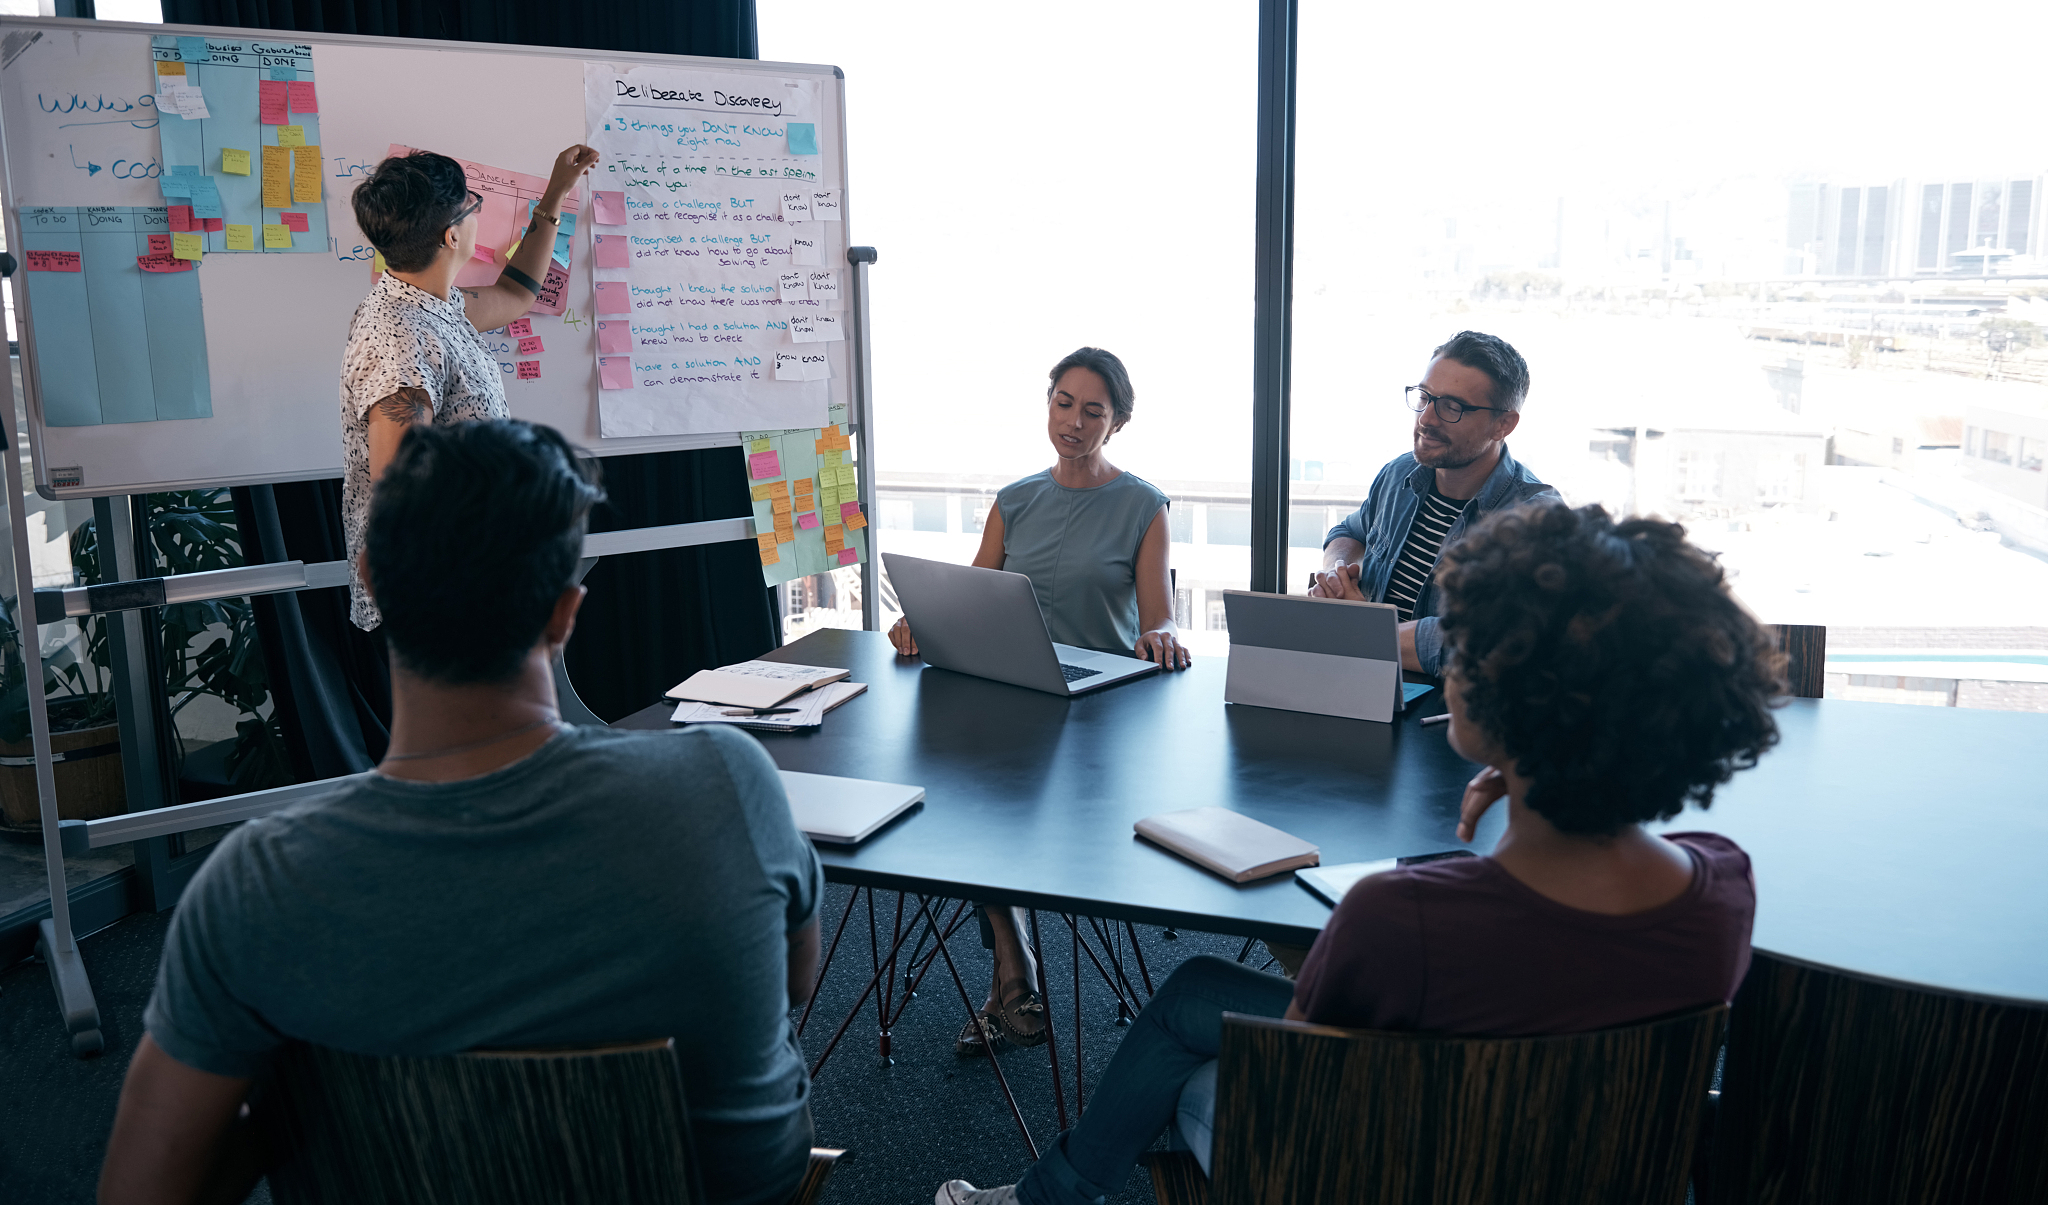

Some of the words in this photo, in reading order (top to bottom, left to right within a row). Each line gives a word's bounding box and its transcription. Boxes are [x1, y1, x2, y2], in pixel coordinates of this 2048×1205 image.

[174, 51, 182, 61] D
[203, 54, 240, 64] OING
[262, 56, 296, 67] DONE
[615, 118, 628, 131] 3
[631, 119, 674, 137] things
[677, 125, 696, 139] you
[743, 124, 784, 137] KNOW
[715, 137, 741, 148] now
[617, 160, 649, 174] Think
[656, 160, 667, 175] of
[673, 166, 681, 174] a
[684, 164, 707, 174] time
[715, 164, 727, 174] in
[731, 164, 752, 176] the
[758, 164, 778, 177] last
[465, 164, 516, 186] SANELE
[624, 178, 660, 188] when
[665, 180, 692, 192] you:
[594, 192, 603, 201] A
[662, 200, 669, 208] a
[673, 198, 722, 213] challenge
[729, 197, 755, 208] BUT
[787, 203, 808, 212] know
[816, 200, 838, 208] know
[52, 215, 67, 224] DO
[88, 213, 123, 226] DOING
[632, 211, 651, 221] did
[654, 211, 670, 221] not
[673, 211, 718, 224] recognise
[721, 211, 728, 220] it
[732, 213, 744, 222] as
[745, 213, 753, 221] a
[755, 210, 802, 227] challe
[595, 234, 603, 244] B
[630, 234, 684, 249] recognised
[700, 234, 743, 247] challenge
[750, 233, 771, 243] BUT
[794, 237, 813, 247] know
[636, 248, 652, 258] did
[654, 249, 669, 257] not
[673, 247, 700, 257] know
[706, 246, 729, 256] how
[732, 247, 742, 255] to
[745, 248, 759, 258] go
[764, 244, 793, 255] about
[718, 257, 756, 269] solving
[759, 257, 769, 266] it
[595, 282, 605, 291] C
[631, 284, 672, 299] thought
[680, 282, 684, 292] I
[688, 283, 716, 294] knew
[720, 283, 735, 294] the
[740, 282, 776, 294] solution
[782, 281, 805, 290] know
[812, 281, 836, 290] know
[636, 298, 654, 309] did
[656, 297, 673, 308] not
[679, 297, 706, 307] know
[710, 297, 735, 307] there
[740, 298, 759, 307] was
[598, 322, 607, 330] D
[631, 322, 675, 337] thought
[679, 322, 684, 331] I
[688, 322, 709, 331] had
[713, 324, 720, 332] a
[723, 321, 760, 332] solution
[765, 320, 788, 331] AND
[640, 334, 668, 346] knew
[672, 332, 694, 343] how
[699, 333, 709, 343] to
[713, 333, 743, 343] check
[599, 357, 608, 366] E
[634, 360, 663, 373] have
[671, 362, 680, 370] a
[685, 359, 727, 370] solution
[733, 356, 762, 367] AND
[801, 355, 825, 363] know
[643, 378, 664, 387] can
[669, 373, 742, 385] demonstrate
[750, 370, 760, 379] it
